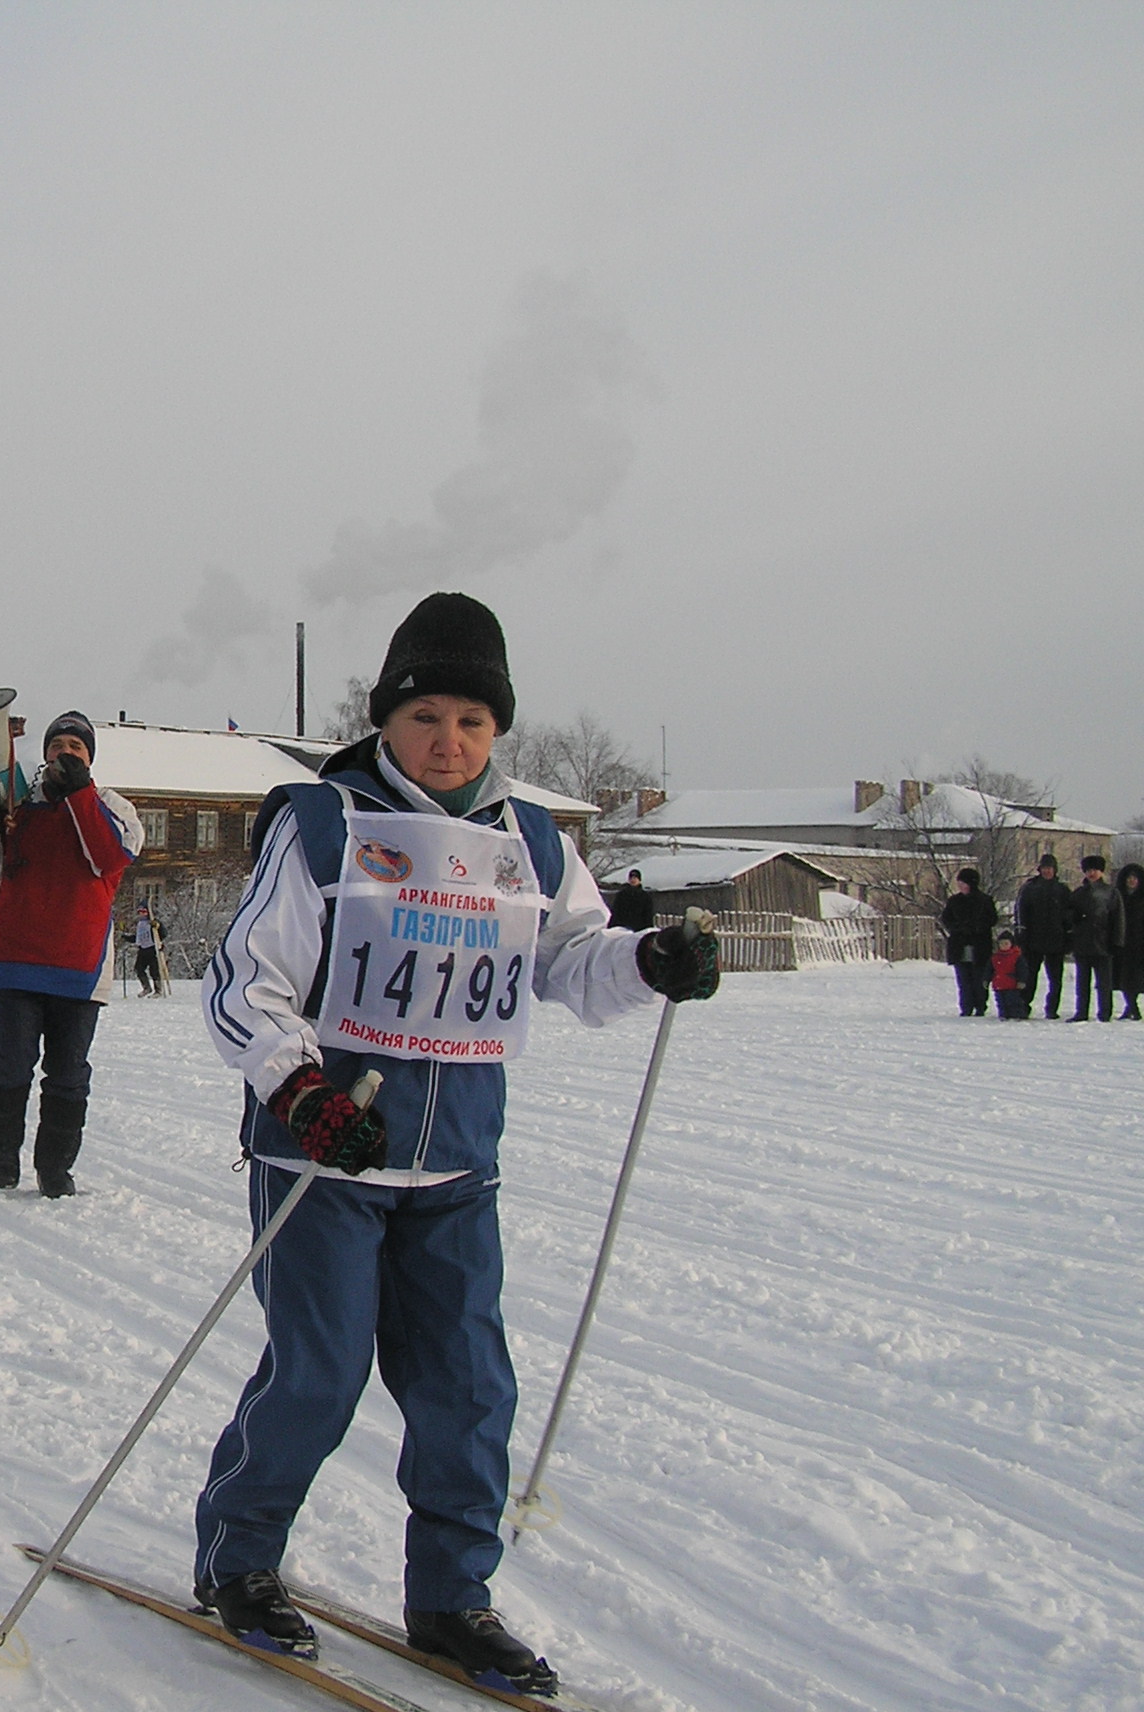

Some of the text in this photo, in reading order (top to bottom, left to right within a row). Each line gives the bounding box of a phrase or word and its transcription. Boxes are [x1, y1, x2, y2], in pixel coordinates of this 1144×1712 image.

[398, 887, 496, 912] АРХАНГЕЛЬСК
[391, 907, 500, 949] ГАЗПРОМ
[352, 941, 522, 1022] 14193
[338, 1018, 504, 1056] ЛЫЖНЯ РОССИИ 2006
